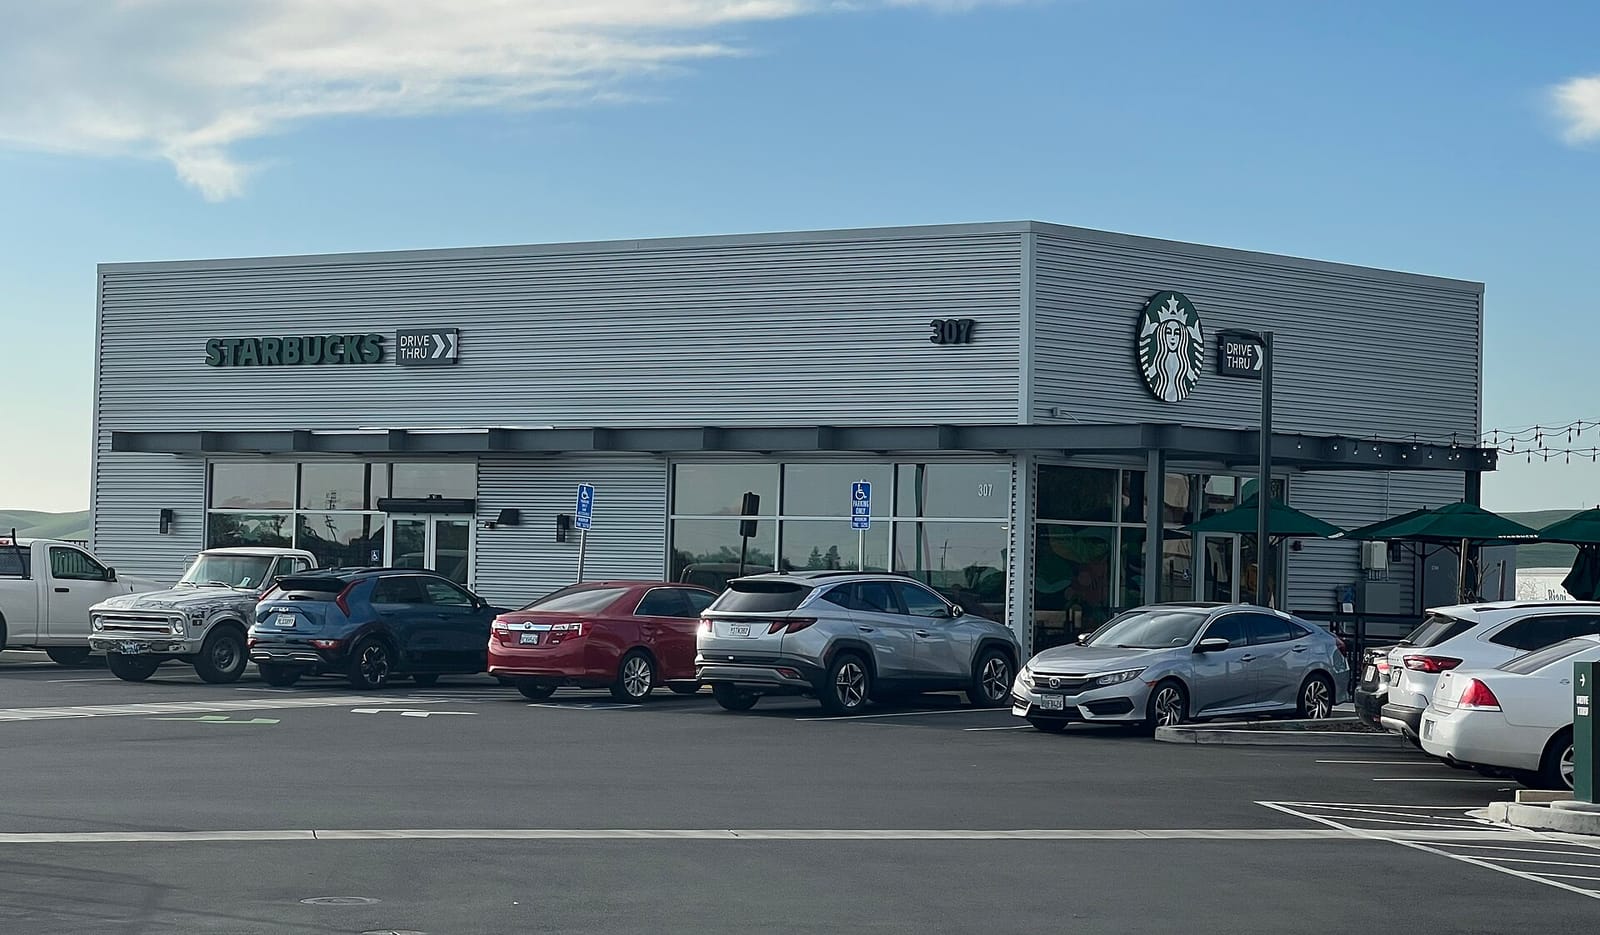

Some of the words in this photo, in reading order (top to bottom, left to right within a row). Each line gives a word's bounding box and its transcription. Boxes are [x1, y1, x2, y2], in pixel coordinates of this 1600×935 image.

[930, 319, 975, 345] 307
[400, 335, 430, 347] DRIVE
[205, 333, 384, 366] STARBUCKS
[400, 347, 427, 359] THRU
[1226, 342, 1253, 357] DRIVE
[1226, 355, 1250, 370] THRU
[977, 484, 993, 496] 307
